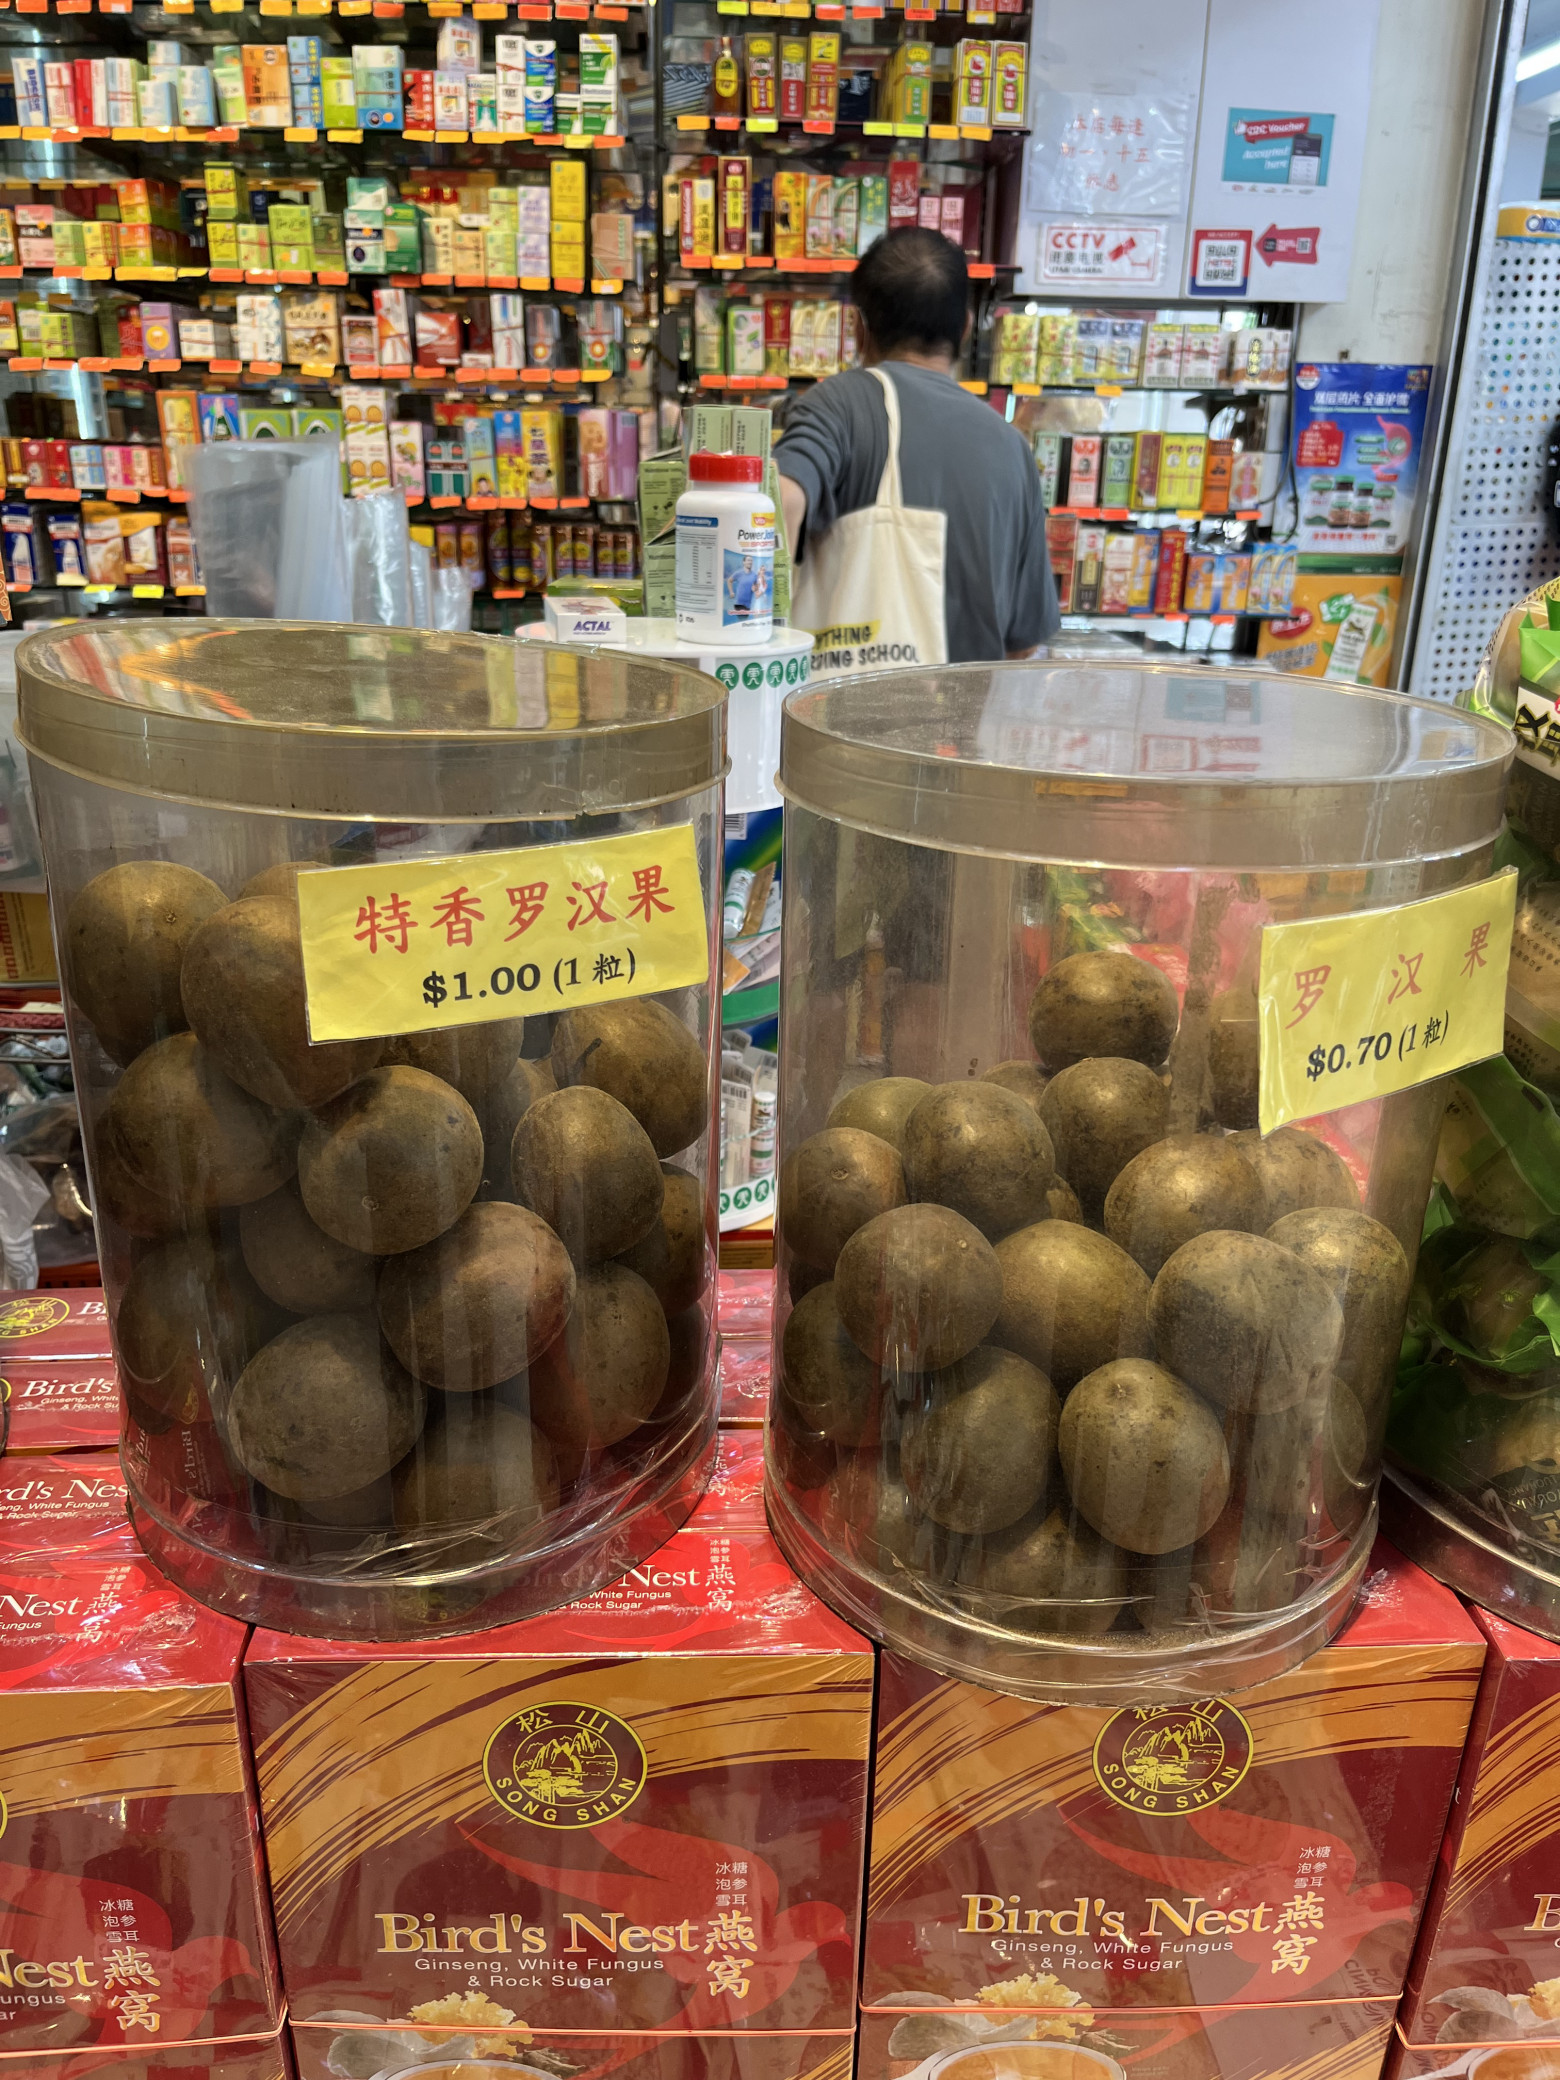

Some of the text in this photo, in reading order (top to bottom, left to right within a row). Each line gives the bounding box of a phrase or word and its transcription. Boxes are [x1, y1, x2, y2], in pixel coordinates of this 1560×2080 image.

[1051, 232, 1105, 249] CCTV
[573, 620, 611, 632] ACTAL
[859, 644, 919, 666] SCHOOL
[353, 864, 676, 955] 特香罗汉果
[1284, 921, 1492, 1030] 罗汉果
[422, 963, 542, 1008] $1.00
[1306, 1031, 1392, 1082] $0.70
[19, 1378, 114, 1397] Bird's
[40, 1396, 87, 1405] Ginseng,
[73, 1403, 101, 1411] Rock
[0, 1479, 129, 1500] rd's Nes
[28, 1502, 62, 1510] White
[65, 1501, 110, 1509] Fungus
[617, 1564, 700, 1588] Nest
[589, 1591, 672, 1599] White Fungus
[705, 1563, 737, 1612] 燕窝
[571, 1601, 643, 1610] Rock Sugar
[514, 1708, 610, 1735] 松山
[1103, 1763, 1240, 1809] SONG SHAN
[496, 1776, 637, 1822] SONG SHAN
[1300, 1845, 1332, 1860] 冰糖
[715, 1861, 748, 1875] 冰糖
[1293, 1876, 1324, 1889] 雪耳
[99, 1899, 135, 1912] 冰糖
[715, 1893, 748, 1907] 雪耳
[958, 1893, 1273, 1937] Bird's Nest
[105, 1930, 140, 1943] 雪耳
[374, 1912, 701, 1954] Bird's Nest
[1270, 1891, 1326, 1976] 燕窝
[702, 1909, 759, 1999] 燕窝
[991, 1939, 1234, 1956] Ginseng, White Fungus
[0, 1949, 100, 1988] est
[415, 1958, 664, 1974] Ginseng, White Fungus
[1041, 1957, 1183, 1972] & Rock Sugar
[102, 1945, 162, 2033] 燕窝
[467, 1975, 613, 1989] & Rock Sugar
[0, 1995, 66, 2007] ungus
